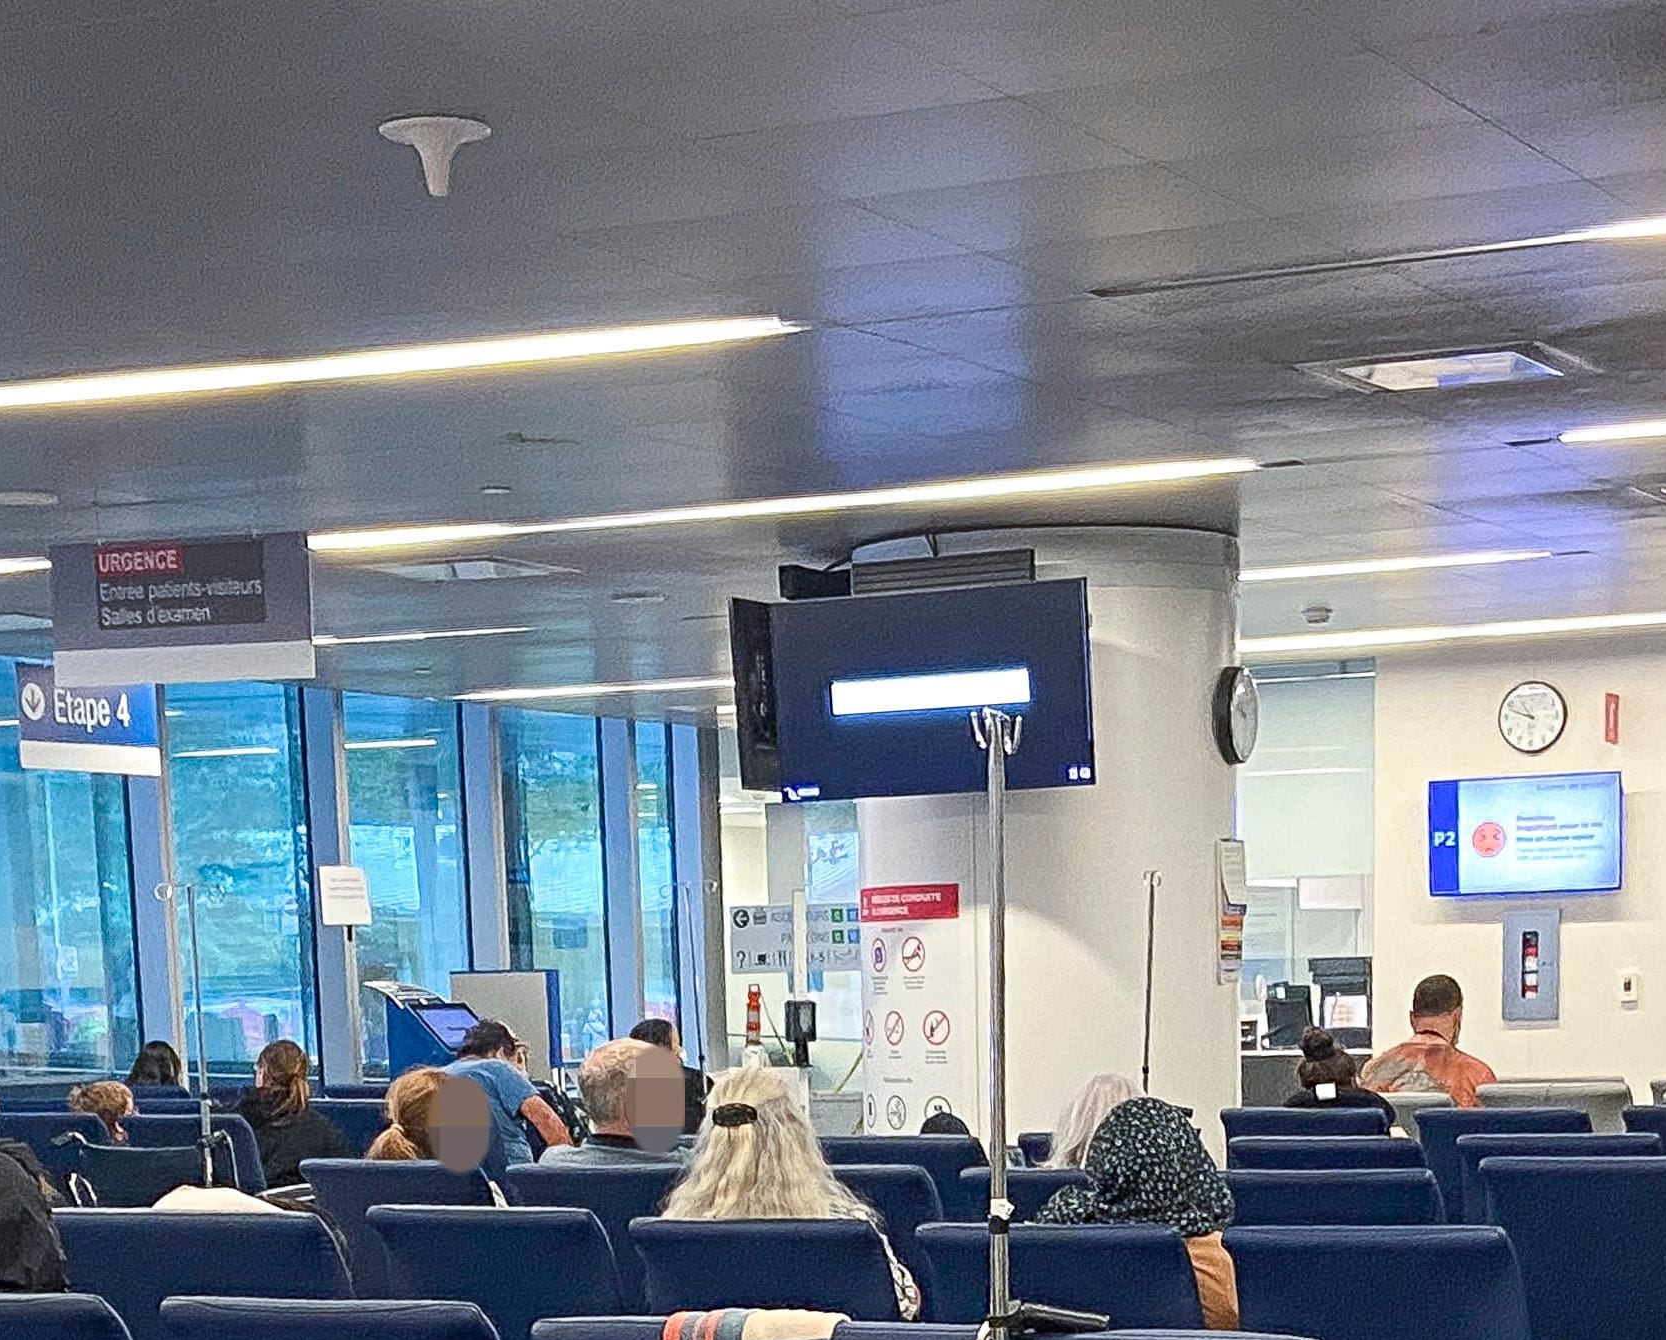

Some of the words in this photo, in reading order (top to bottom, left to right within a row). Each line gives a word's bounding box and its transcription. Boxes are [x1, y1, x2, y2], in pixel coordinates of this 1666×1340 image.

[98, 549, 179, 574] URGENCE
[116, 692, 131, 728] 4
[1433, 831, 1456, 848] P2
